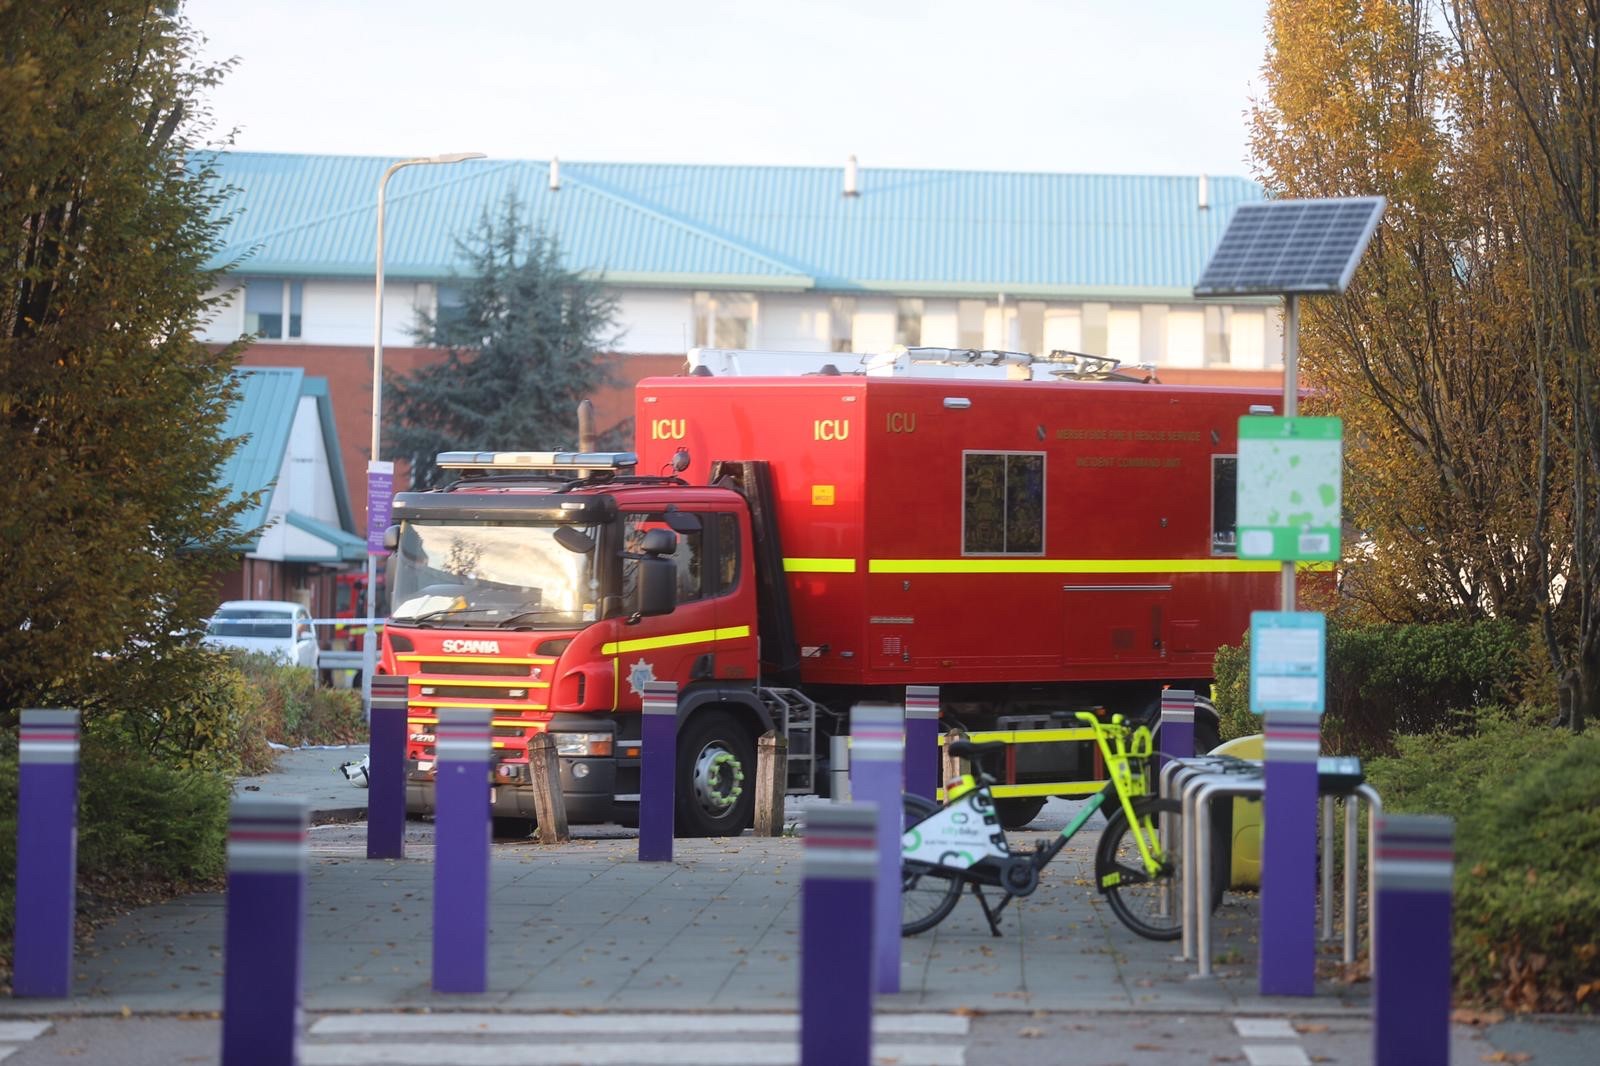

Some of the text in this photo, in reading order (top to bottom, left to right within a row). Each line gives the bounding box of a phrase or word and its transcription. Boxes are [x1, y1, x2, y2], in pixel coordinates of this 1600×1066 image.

[652, 419, 686, 440] ICU
[814, 420, 849, 441] ICU
[886, 412, 916, 433] ICU
[1056, 429, 1105, 441] MERSEYSIDE
[1167, 431, 1201, 442] SERVICE
[442, 639, 500, 654] SCANIA
